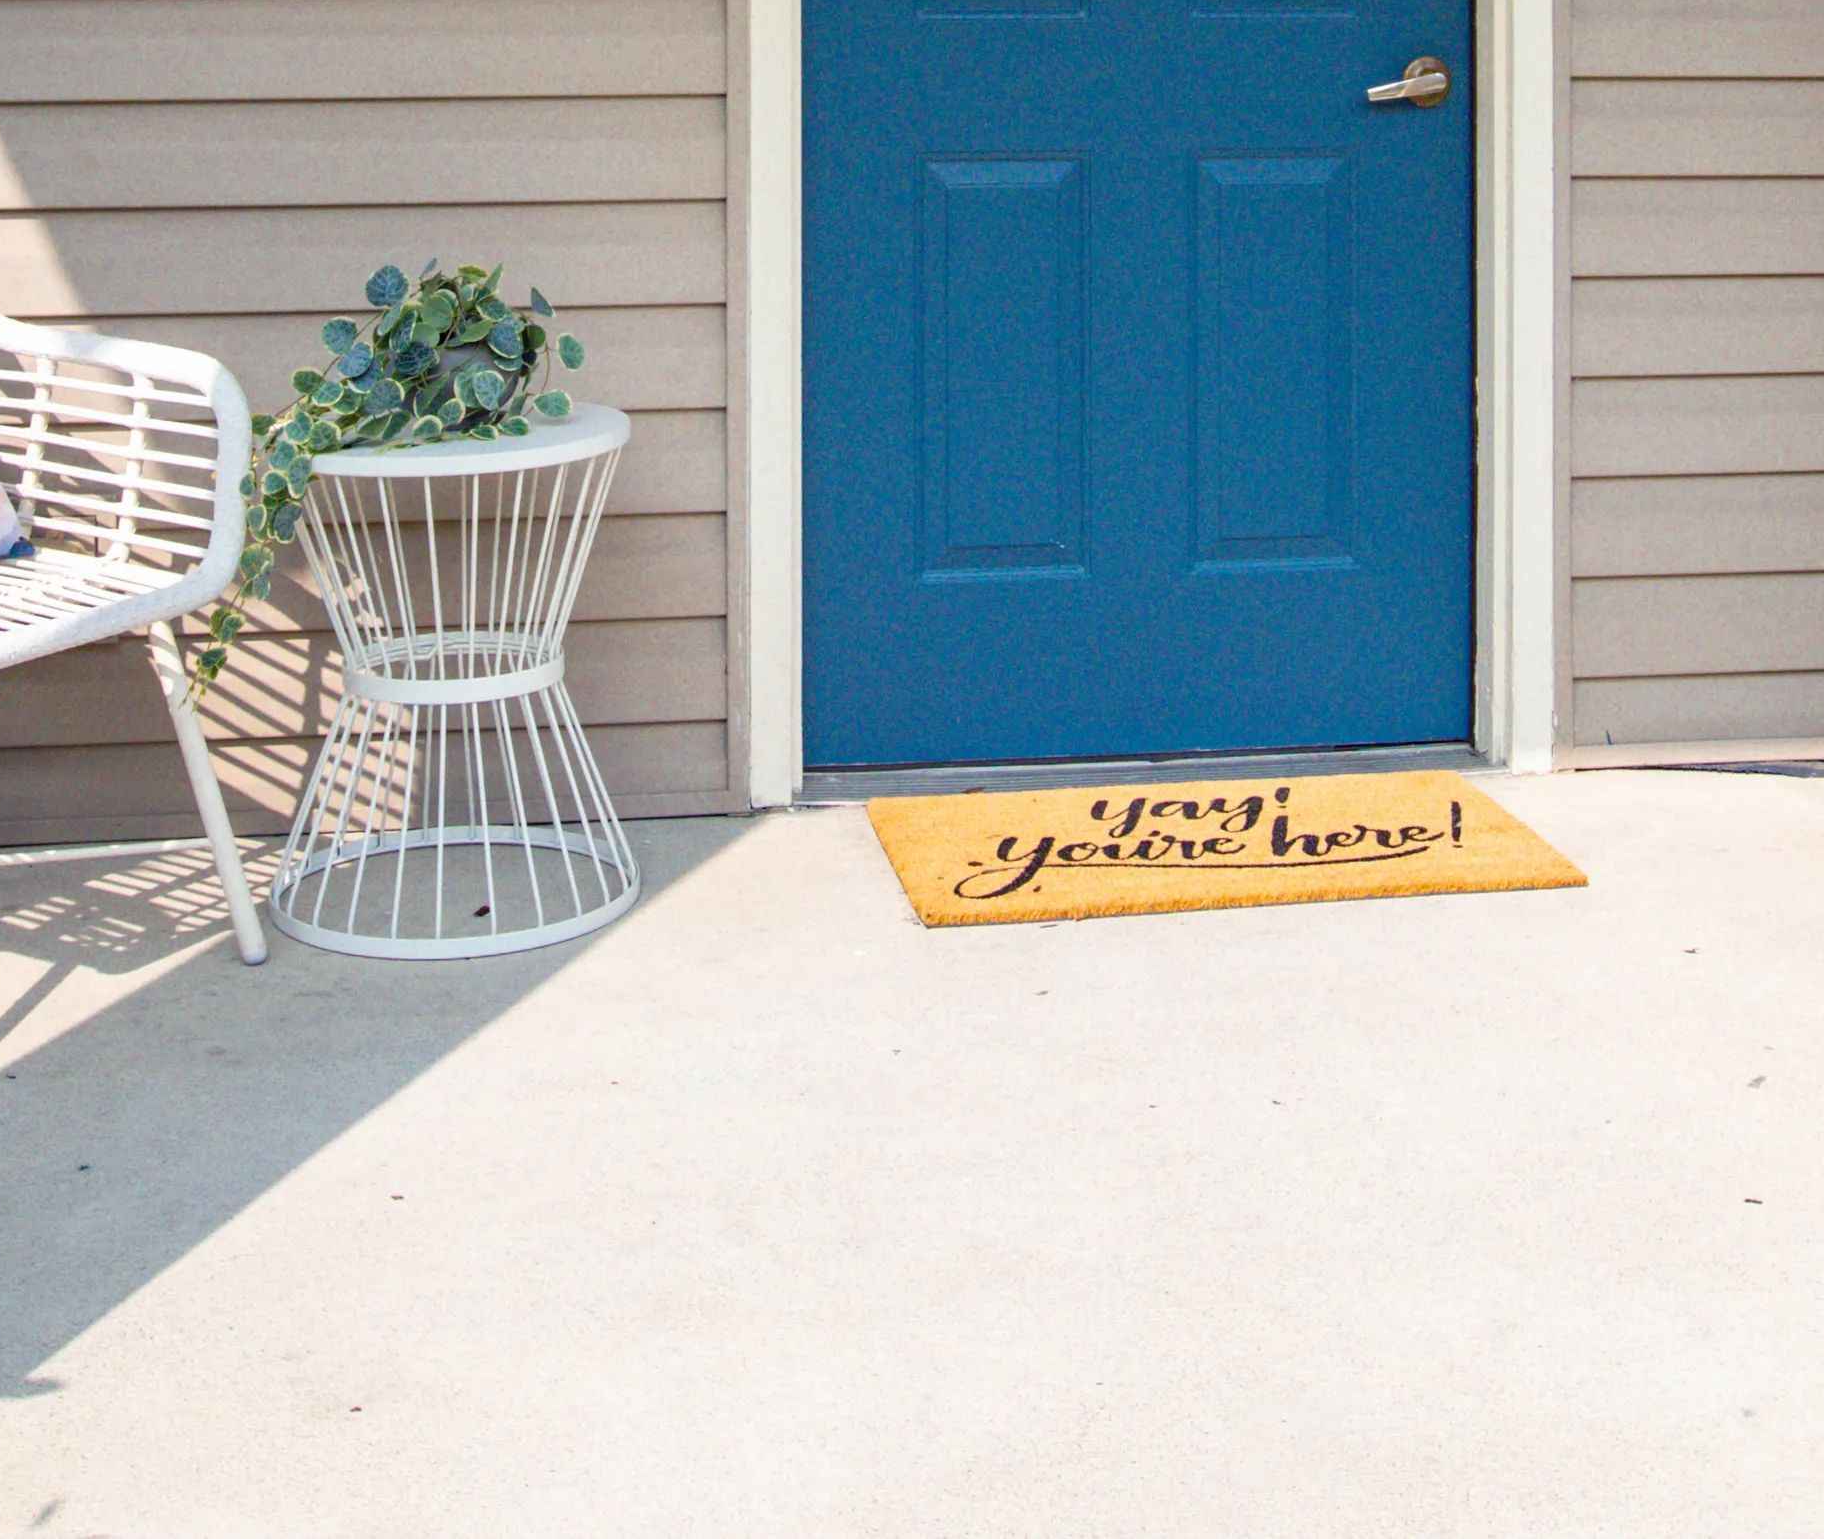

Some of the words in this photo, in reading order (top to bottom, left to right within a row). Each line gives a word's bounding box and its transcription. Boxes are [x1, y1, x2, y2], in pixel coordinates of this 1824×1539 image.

[953, 830, 1247, 900] you're
[1271, 800, 1464, 858] here!
[1090, 786, 1291, 839] yay!
